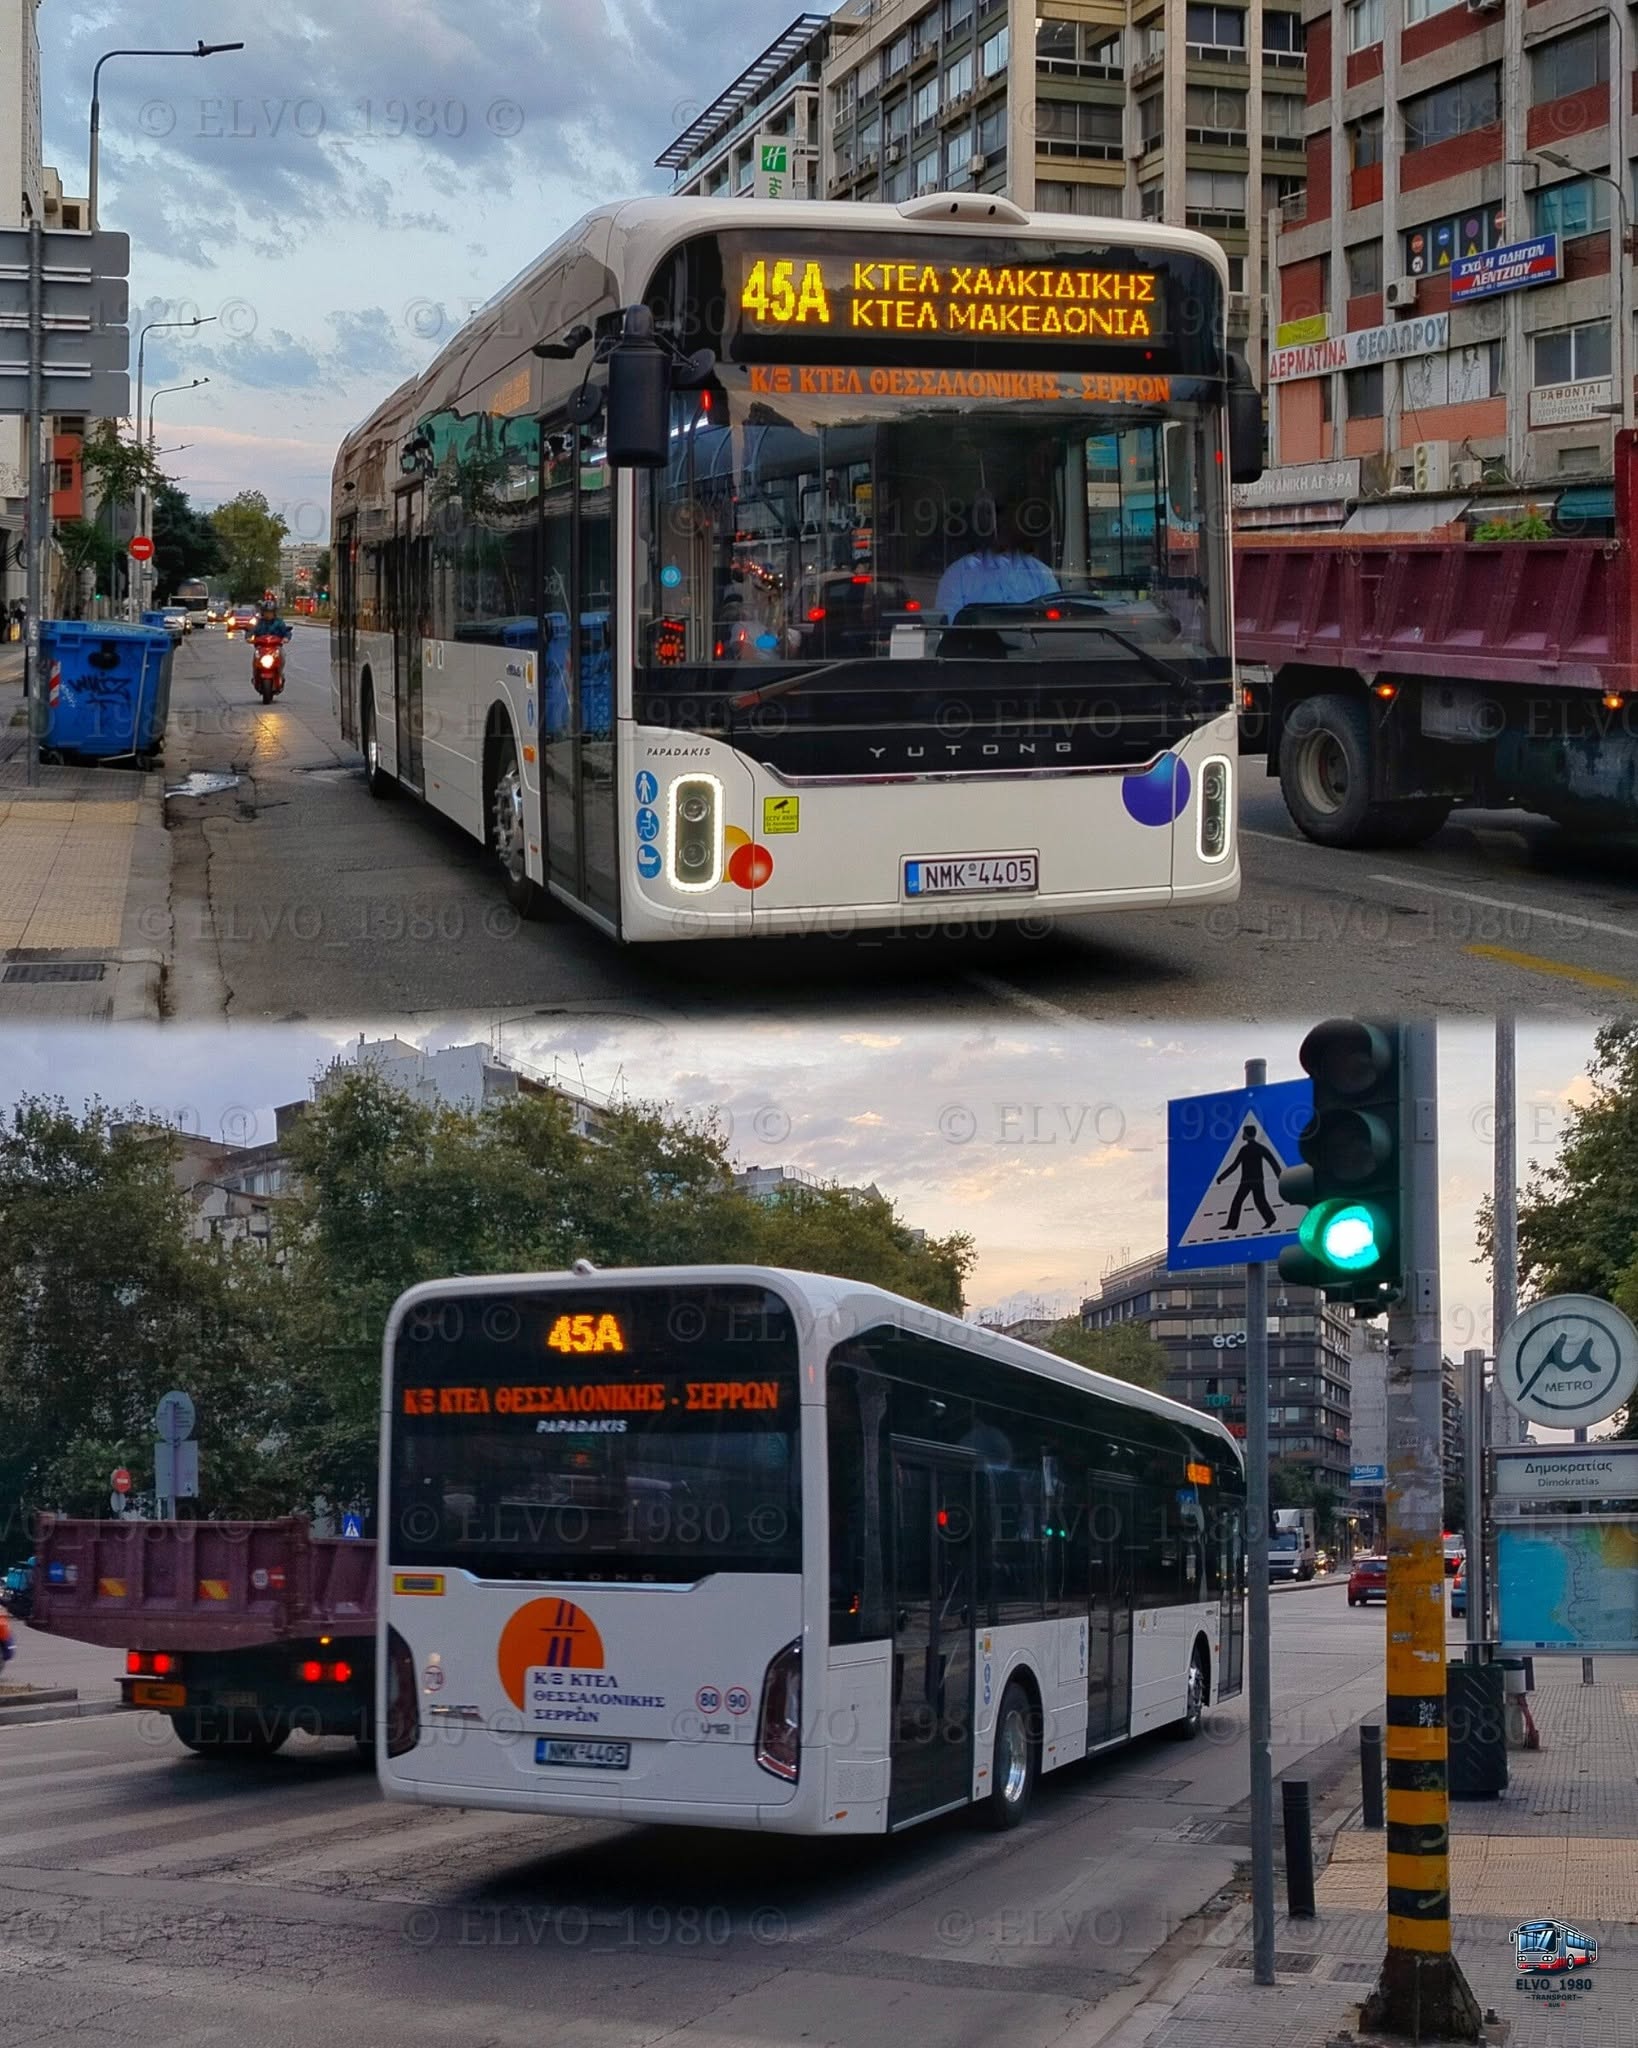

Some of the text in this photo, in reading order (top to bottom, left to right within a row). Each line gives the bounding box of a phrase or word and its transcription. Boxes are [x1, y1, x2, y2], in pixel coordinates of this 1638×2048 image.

[854, 263, 1155, 301] ΚΤΕΛ ΧΑΛΚΙΔΙΚΗΣ
[741, 259, 829, 323] 45A
[853, 299, 938, 328] ΚΤΕΛ
[950, 303, 1149, 336] ΜΑΚΕΔΟΝΙΑ
[1270, 338, 1347, 378] ΔΕΡΜΑΤΙΝΑ
[800, 367, 863, 394] ΚΤΕΛ
[869, 367, 1060, 400] ΘΕΣΣΑΛΟΝΙΚΗΣ
[1081, 374, 1171, 403] ΣΕΡΡΩΝ
[647, 748, 711, 757] PAPADAKIS
[870, 742, 1072, 758] YUTONG
[547, 1314, 624, 1353] 45A
[1545, 1380, 1593, 1393] METRO
[495, 1384, 665, 1414] ΘΕΣΣΑΛΟΝΙΚΗΣ
[685, 1382, 779, 1411] ΣΕΡΡΩΝ
[536, 1420, 628, 1434] PAPADAKIS
[1354, 1465, 1379, 1475] beko
[1525, 1459, 1613, 1474] Δημοκρατίας
[1537, 1477, 1600, 1488] Dimokratias
[571, 1673, 618, 1688] ΚΤΕΛ
[533, 1690, 666, 1708] ΘΕΣΣΑΛΟΝΙΚΗΣ
[701, 1693, 718, 1707] 80
[729, 1694, 746, 1708] 90
